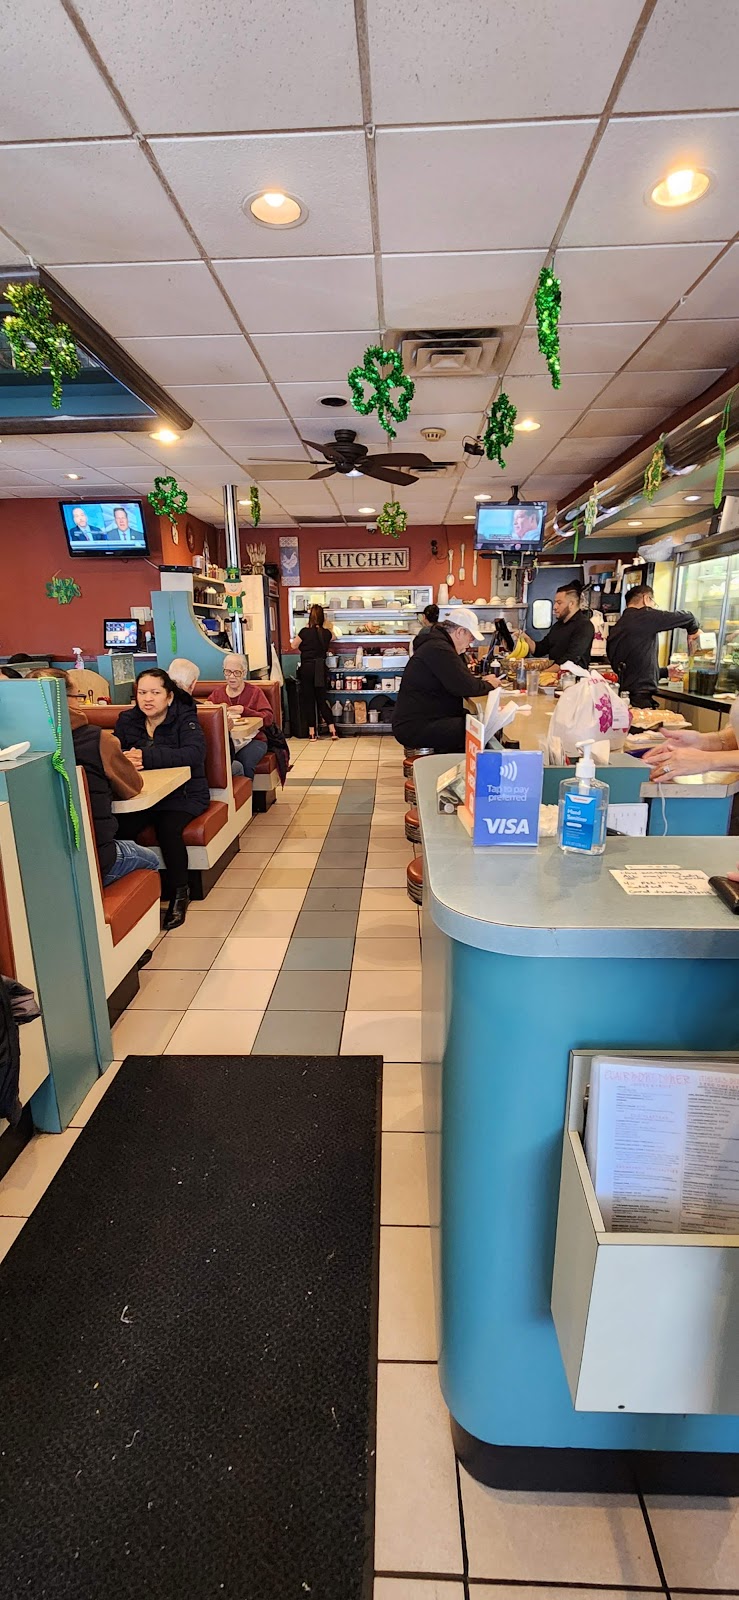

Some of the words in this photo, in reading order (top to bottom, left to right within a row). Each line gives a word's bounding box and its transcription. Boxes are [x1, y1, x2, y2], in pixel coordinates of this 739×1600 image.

[323, 552, 404, 568] KITCHEN
[487, 785, 502, 795] Tap
[503, 785, 512, 793] to
[513, 785, 530, 795] pay
[488, 793, 527, 803] preferred
[482, 818, 530, 835] VISA
